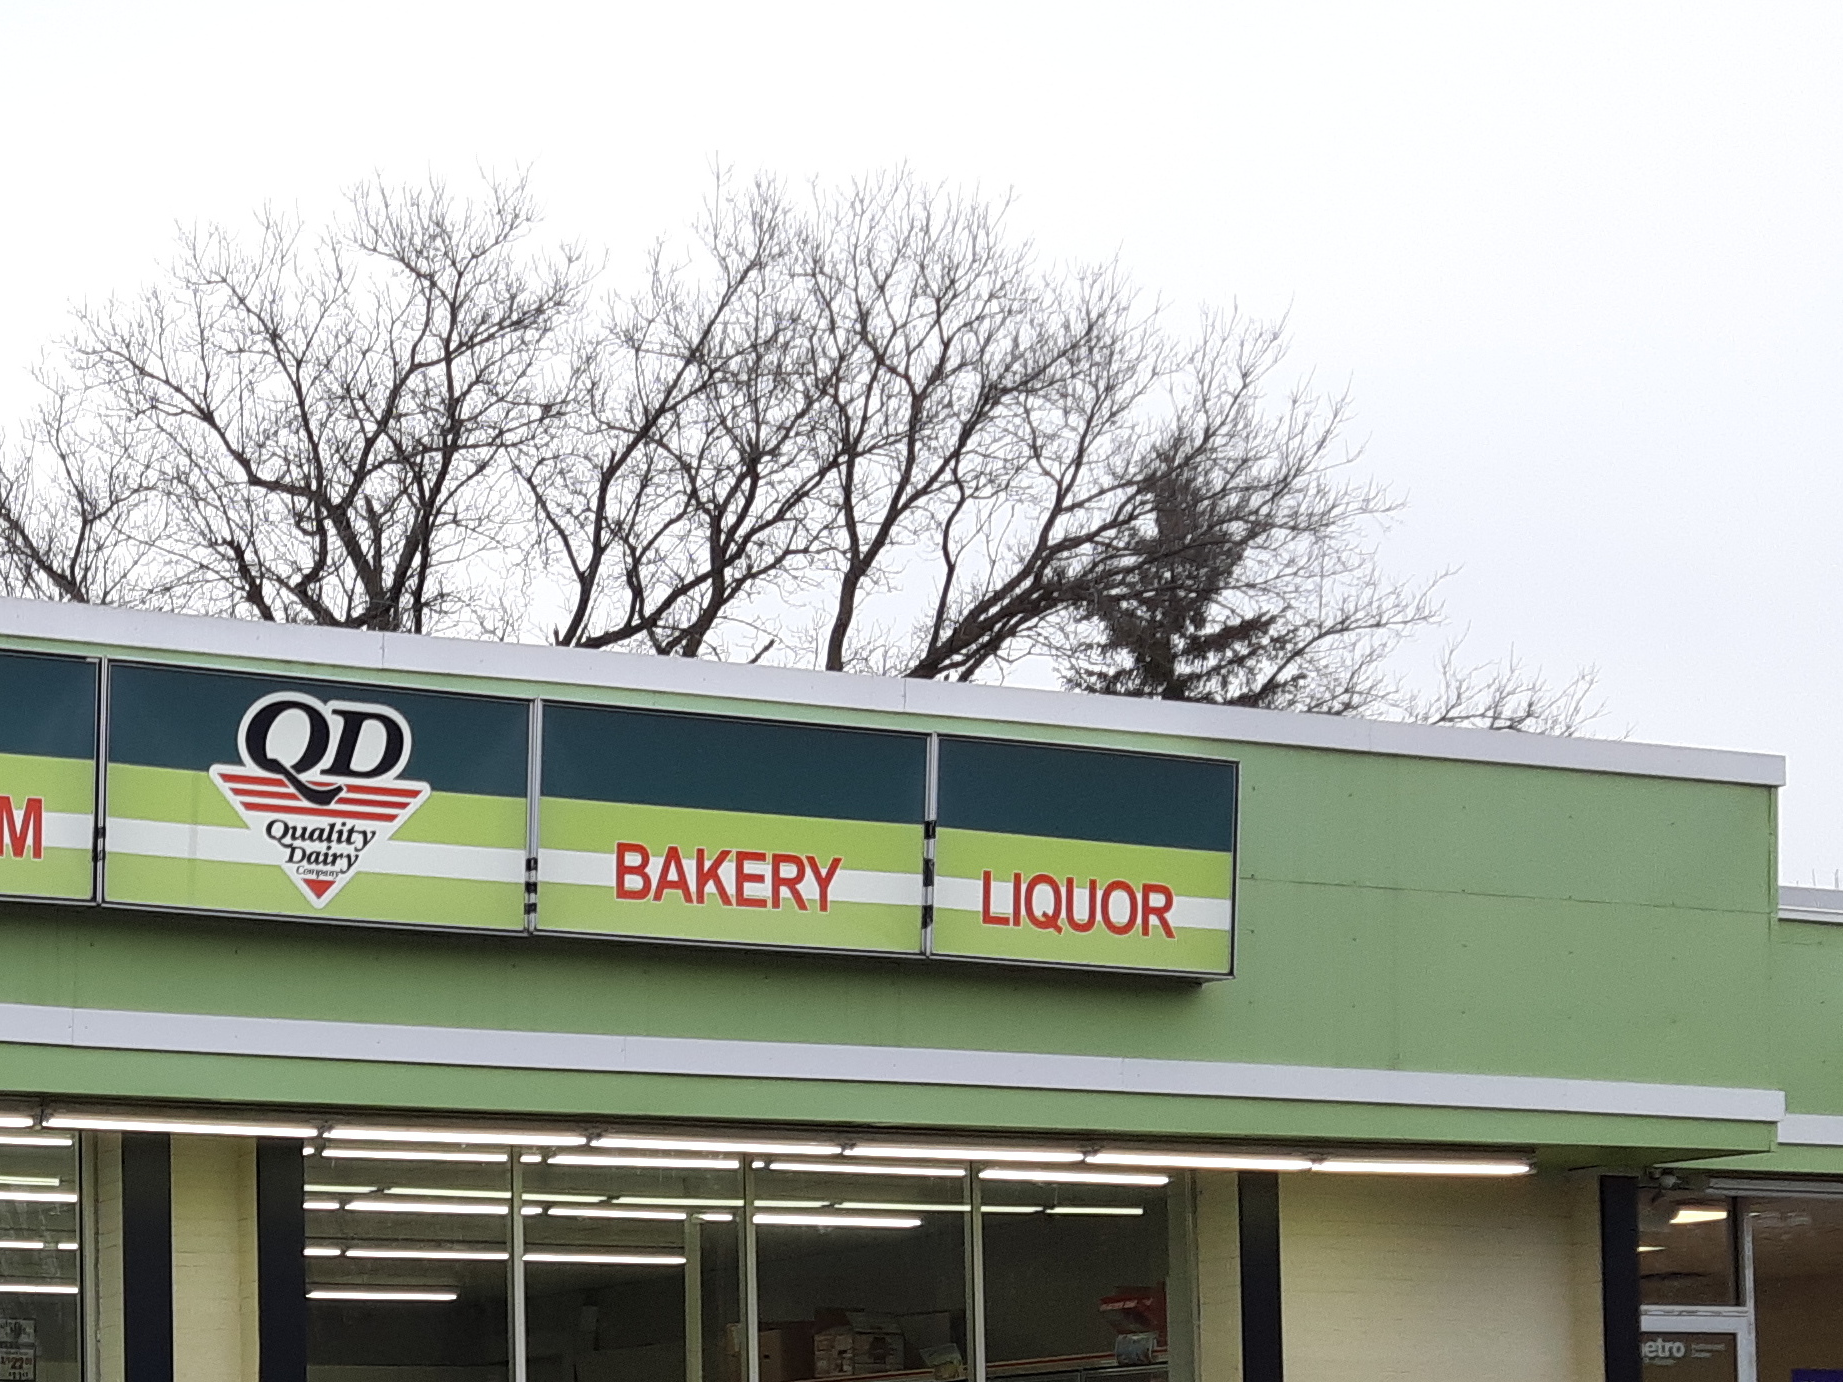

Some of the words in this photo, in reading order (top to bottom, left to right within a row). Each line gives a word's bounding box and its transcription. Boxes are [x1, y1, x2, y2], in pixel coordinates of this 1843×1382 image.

[244, 700, 404, 806] QD
[265, 818, 377, 852] Quality
[285, 845, 360, 873] Dairy
[295, 864, 342, 880] Company
[615, 841, 844, 913] BAKERY
[981, 868, 1177, 940] LIQUOR
[1641, 1337, 1686, 1358] etro
